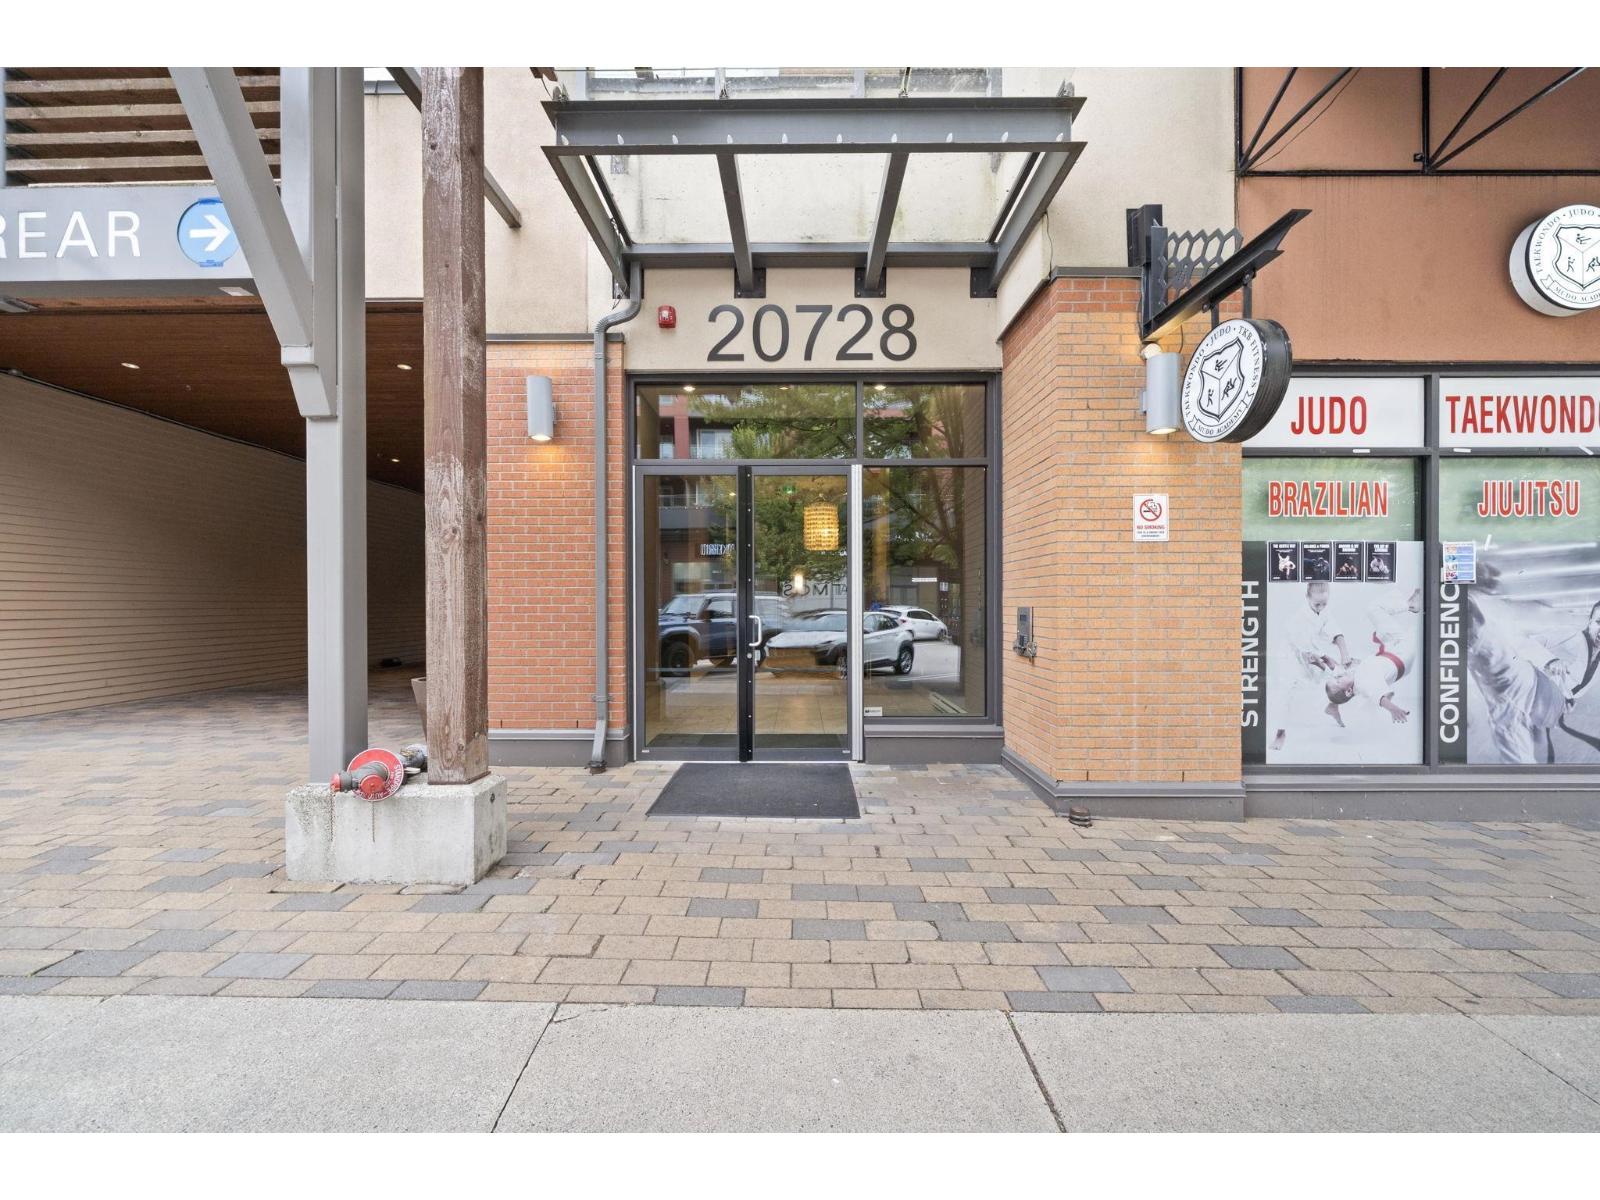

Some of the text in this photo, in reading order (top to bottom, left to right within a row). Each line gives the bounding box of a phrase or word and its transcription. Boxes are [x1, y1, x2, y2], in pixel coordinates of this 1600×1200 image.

[1569, 208, 1595, 218] JUDO
[0, 211, 141, 258] EAR
[707, 303, 917, 362] 20728
[1184, 325, 1261, 417] TAEKWONDO JUDO TKB FITNESS
[1198, 409, 1242, 435] MUDO ACADEMY
[1290, 396, 1367, 435] JUDO
[1445, 395, 1600, 434] TAEKWOND
[1268, 480, 1389, 518] BRAZILIAN
[1478, 479, 1580, 518] JIUJITSU
[1241, 580, 1259, 728] STRENGTH
[1440, 569, 1460, 743] CONFIDENC
